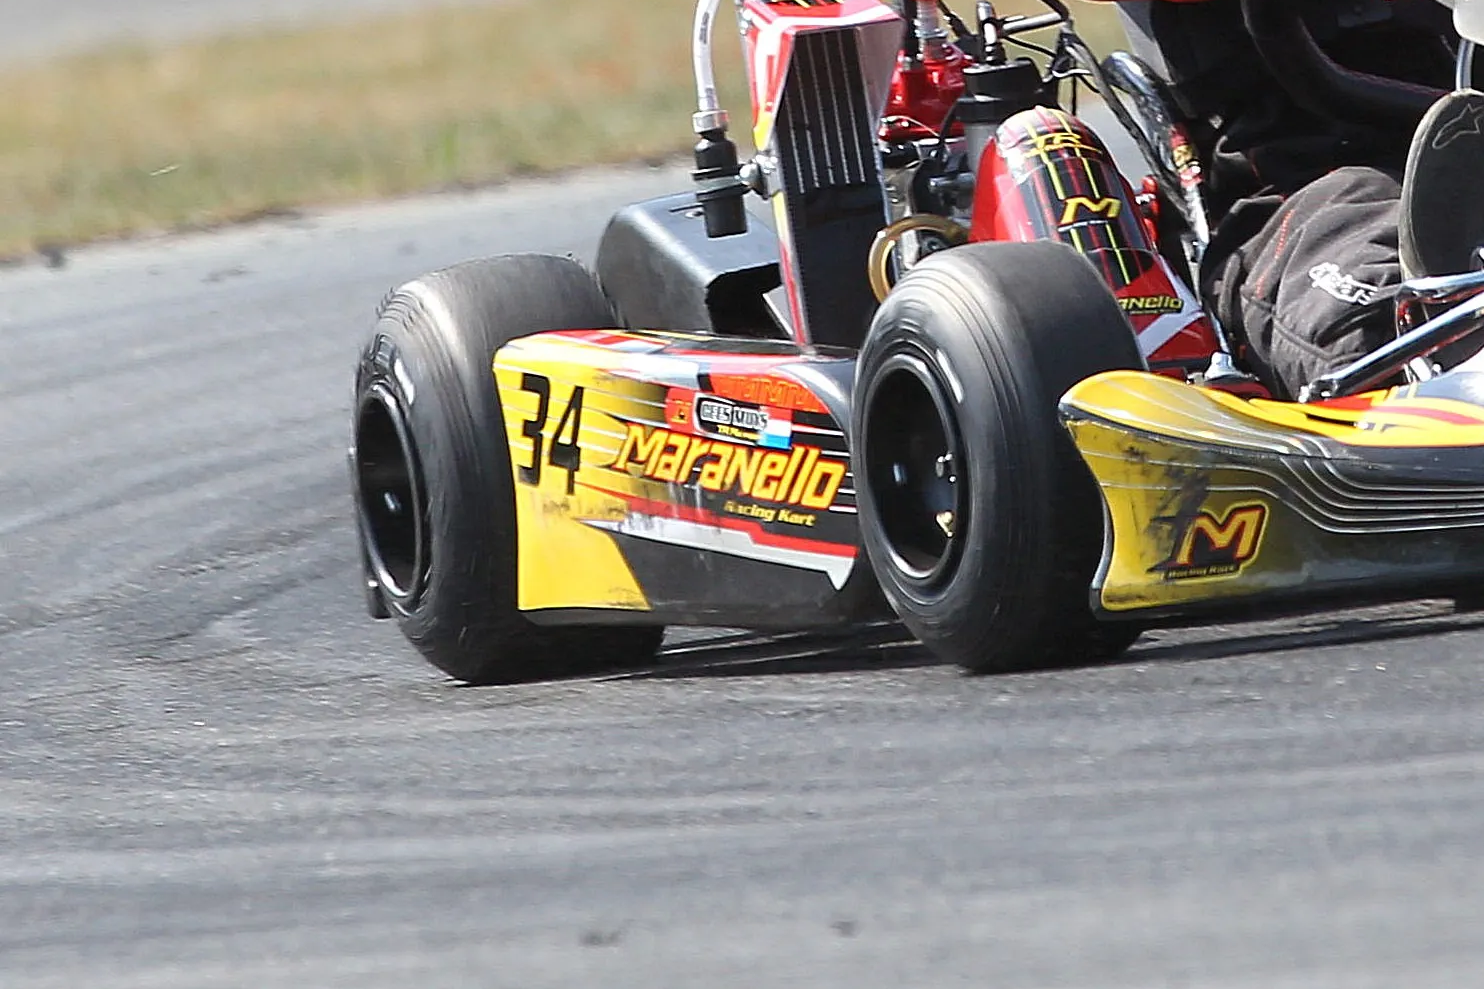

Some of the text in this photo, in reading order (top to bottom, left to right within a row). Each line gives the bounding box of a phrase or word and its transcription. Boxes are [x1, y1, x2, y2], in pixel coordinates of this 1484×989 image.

[1059, 195, 1123, 227] M
[510, 372, 585, 495] 34
[612, 422, 848, 510] Maranello
[724, 501, 817, 527] Racing Kart
[1174, 507, 1263, 565] M
